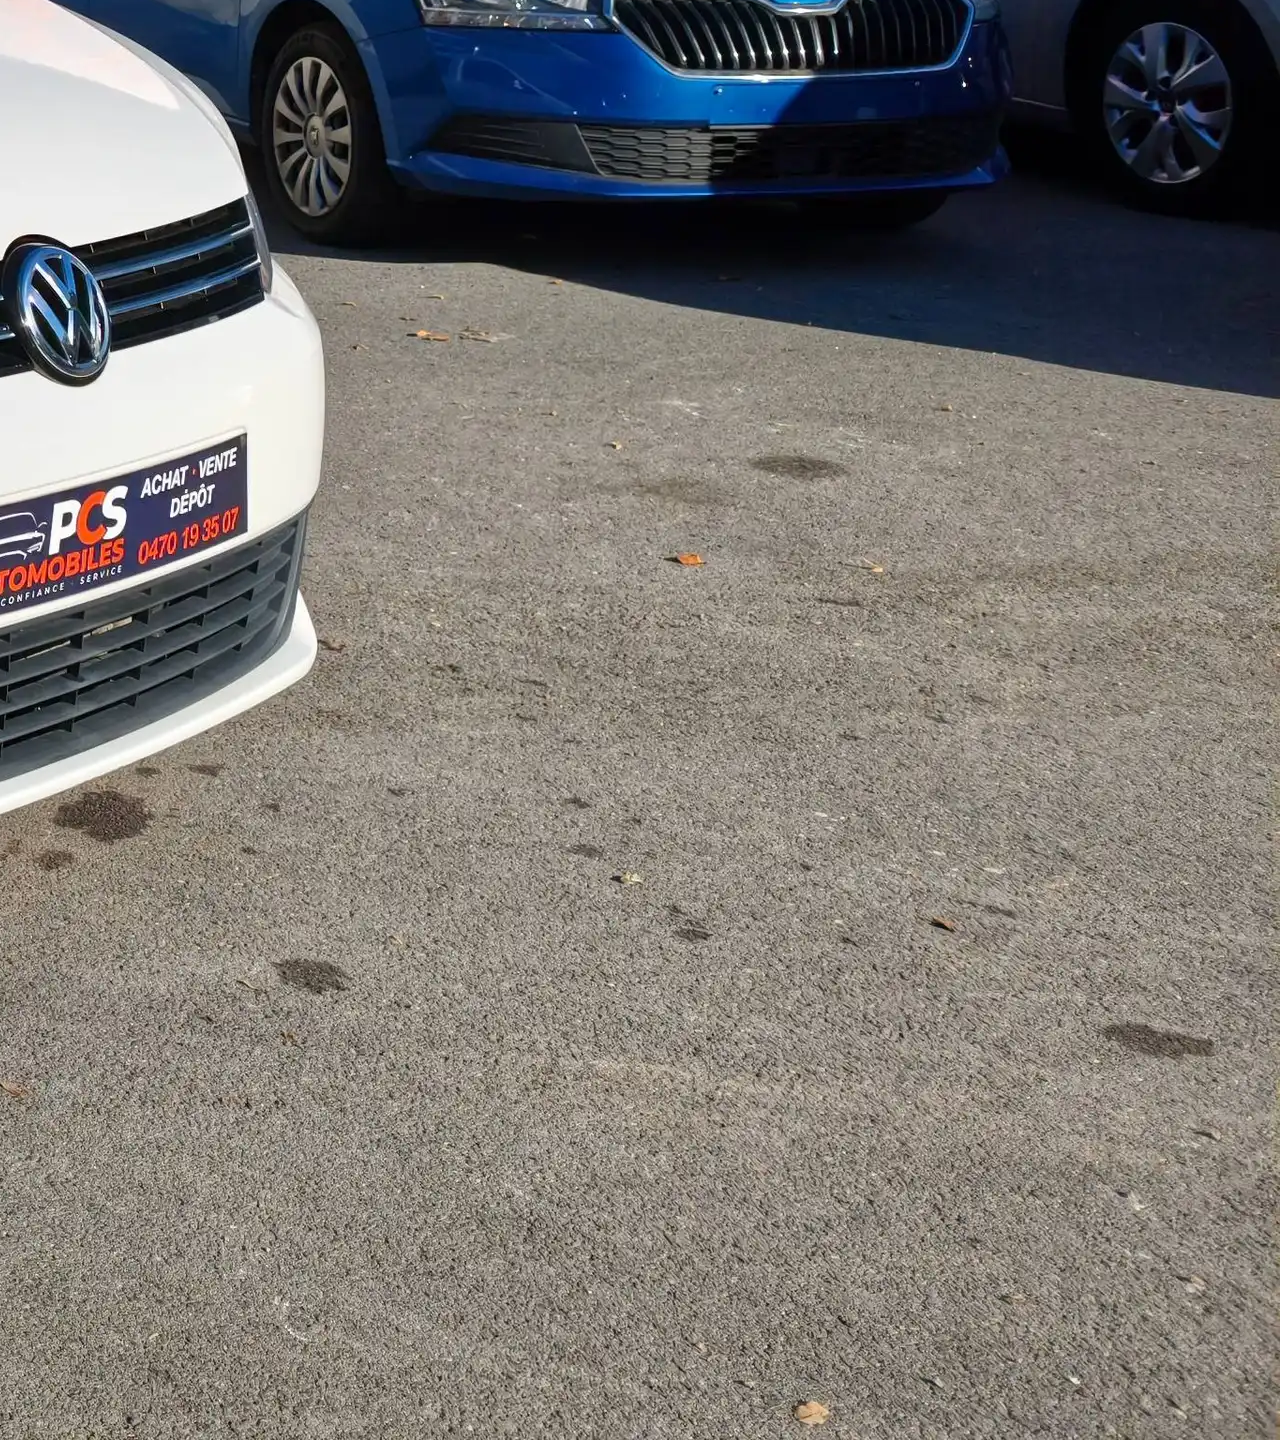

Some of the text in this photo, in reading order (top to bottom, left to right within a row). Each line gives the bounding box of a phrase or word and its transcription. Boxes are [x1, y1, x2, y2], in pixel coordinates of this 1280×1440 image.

[140, 446, 238, 499] ACHAT VENTE
[48, 485, 129, 556] PCS
[169, 483, 216, 518] DÉPÔT
[138, 506, 240, 565] 0470 19 35 07
[0, 582, 66, 607] CONFIANCE
[79, 565, 124, 585] SERVICE
